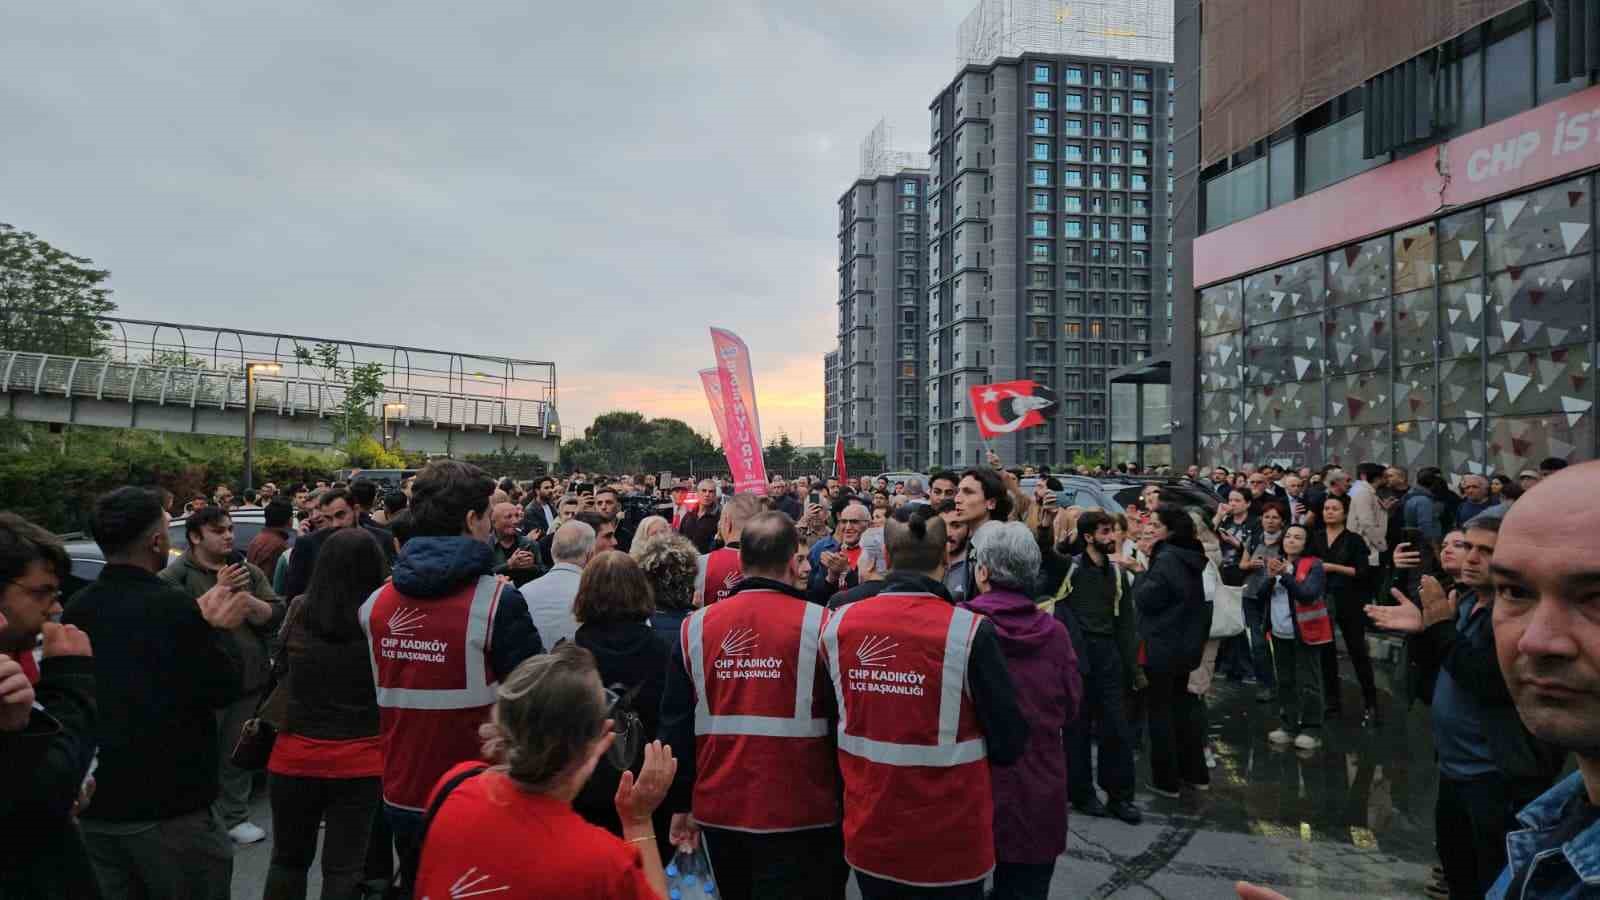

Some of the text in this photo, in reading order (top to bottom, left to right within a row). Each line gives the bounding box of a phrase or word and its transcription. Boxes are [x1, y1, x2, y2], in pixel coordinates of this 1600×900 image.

[1467, 131, 1540, 182] CHP
[381, 638, 448, 652] CHP KADIKÖY
[397, 651, 446, 663] BAŞKANLIĞI
[714, 656, 783, 669] CHP KADIKÖY
[733, 669, 781, 680] BAŞKANLIĞI
[848, 669, 926, 685] CHP KADIKÖY
[867, 682, 924, 697] BAŞKANLIĞI
